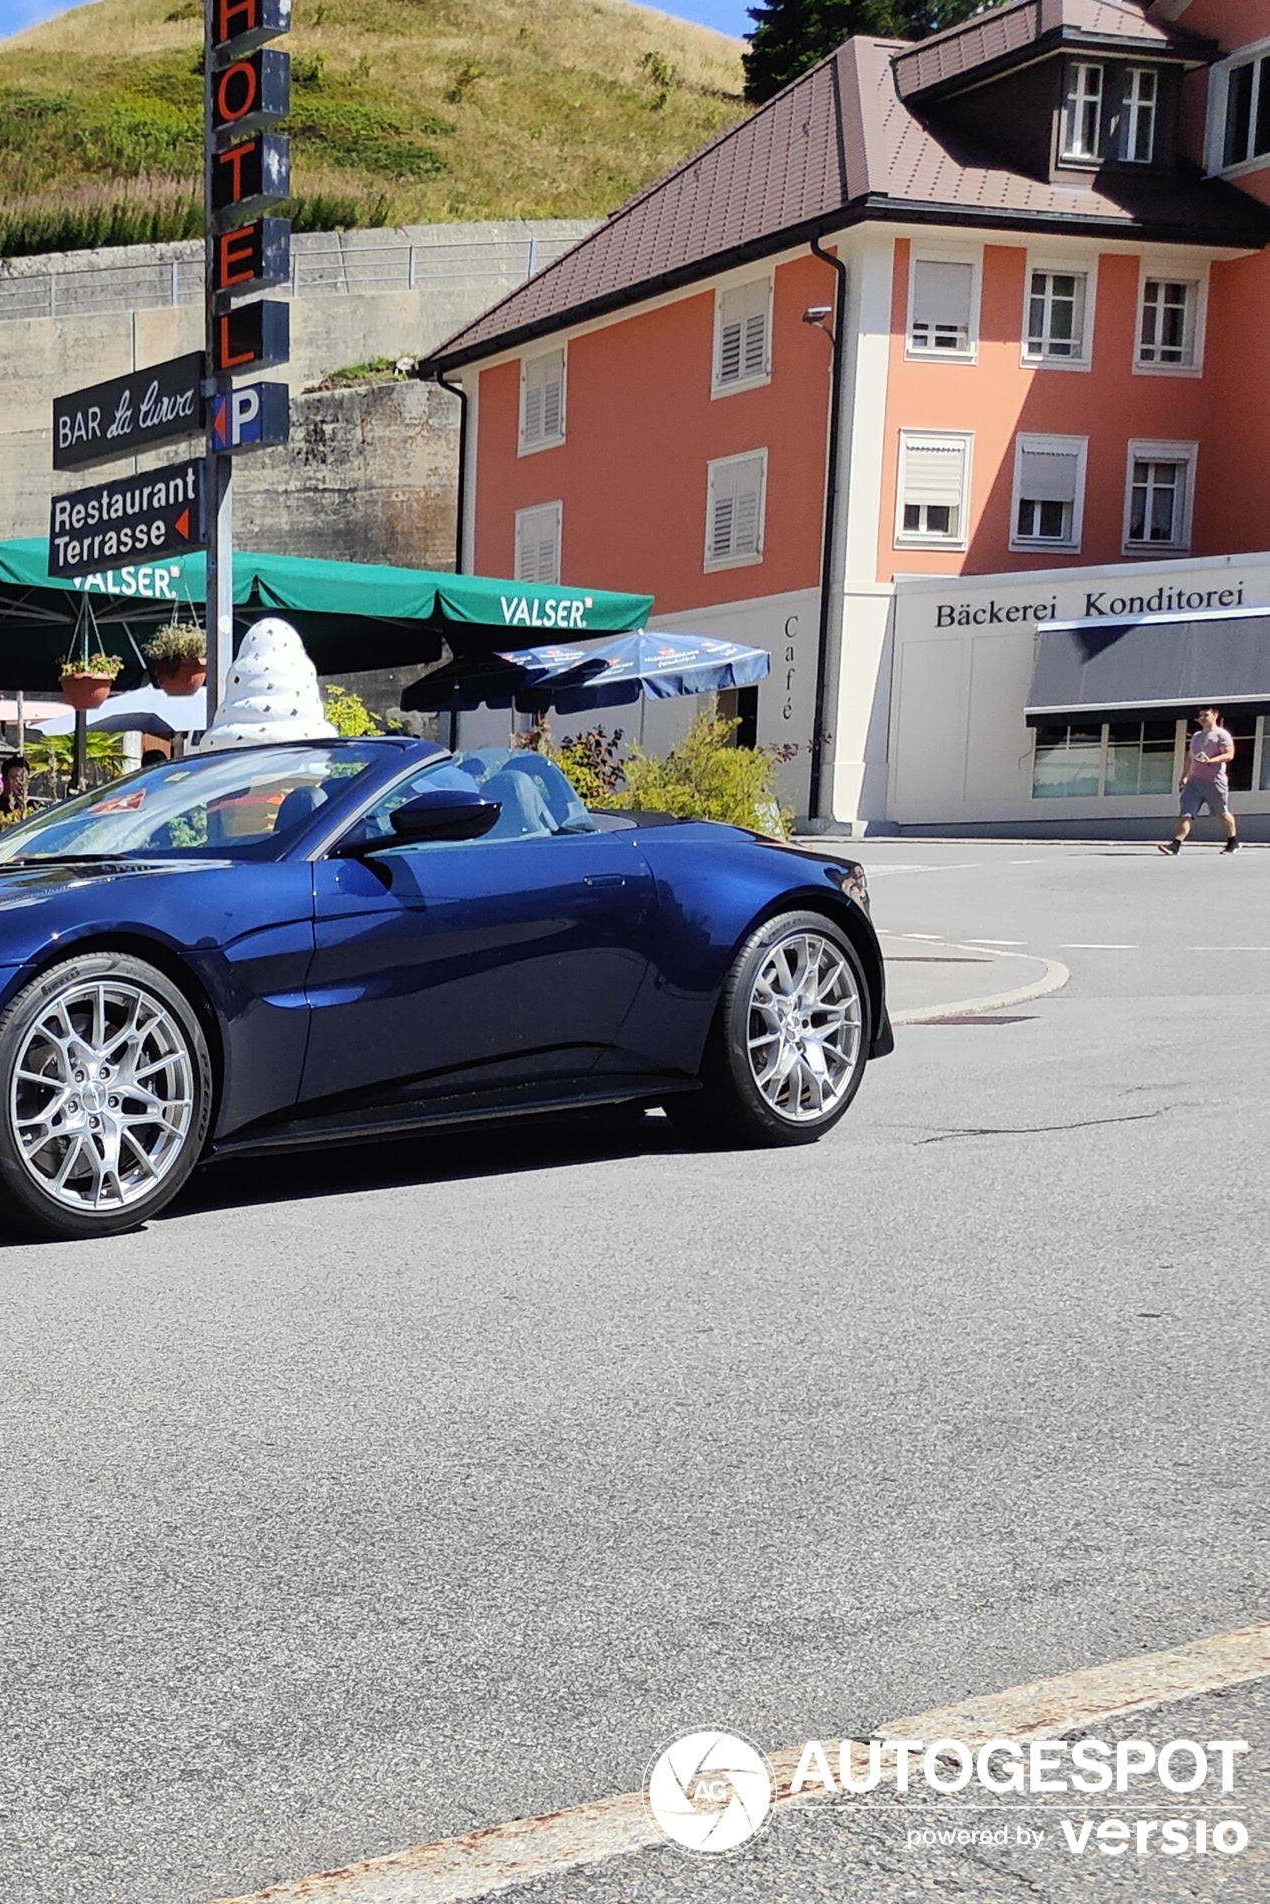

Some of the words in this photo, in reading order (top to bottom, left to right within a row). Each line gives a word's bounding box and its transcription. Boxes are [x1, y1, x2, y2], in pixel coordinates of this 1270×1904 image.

[219, 0, 256, 369] HOTEL
[58, 406, 101, 449] BAR
[232, 389, 260, 445] P
[54, 467, 196, 533] Restaurant
[54, 520, 166, 567] Terrasse
[499, 595, 587, 628] VALSER
[935, 595, 1058, 628] Bäckerei
[1083, 580, 1245, 617] Konditorei
[782, 615, 799, 720] Café
